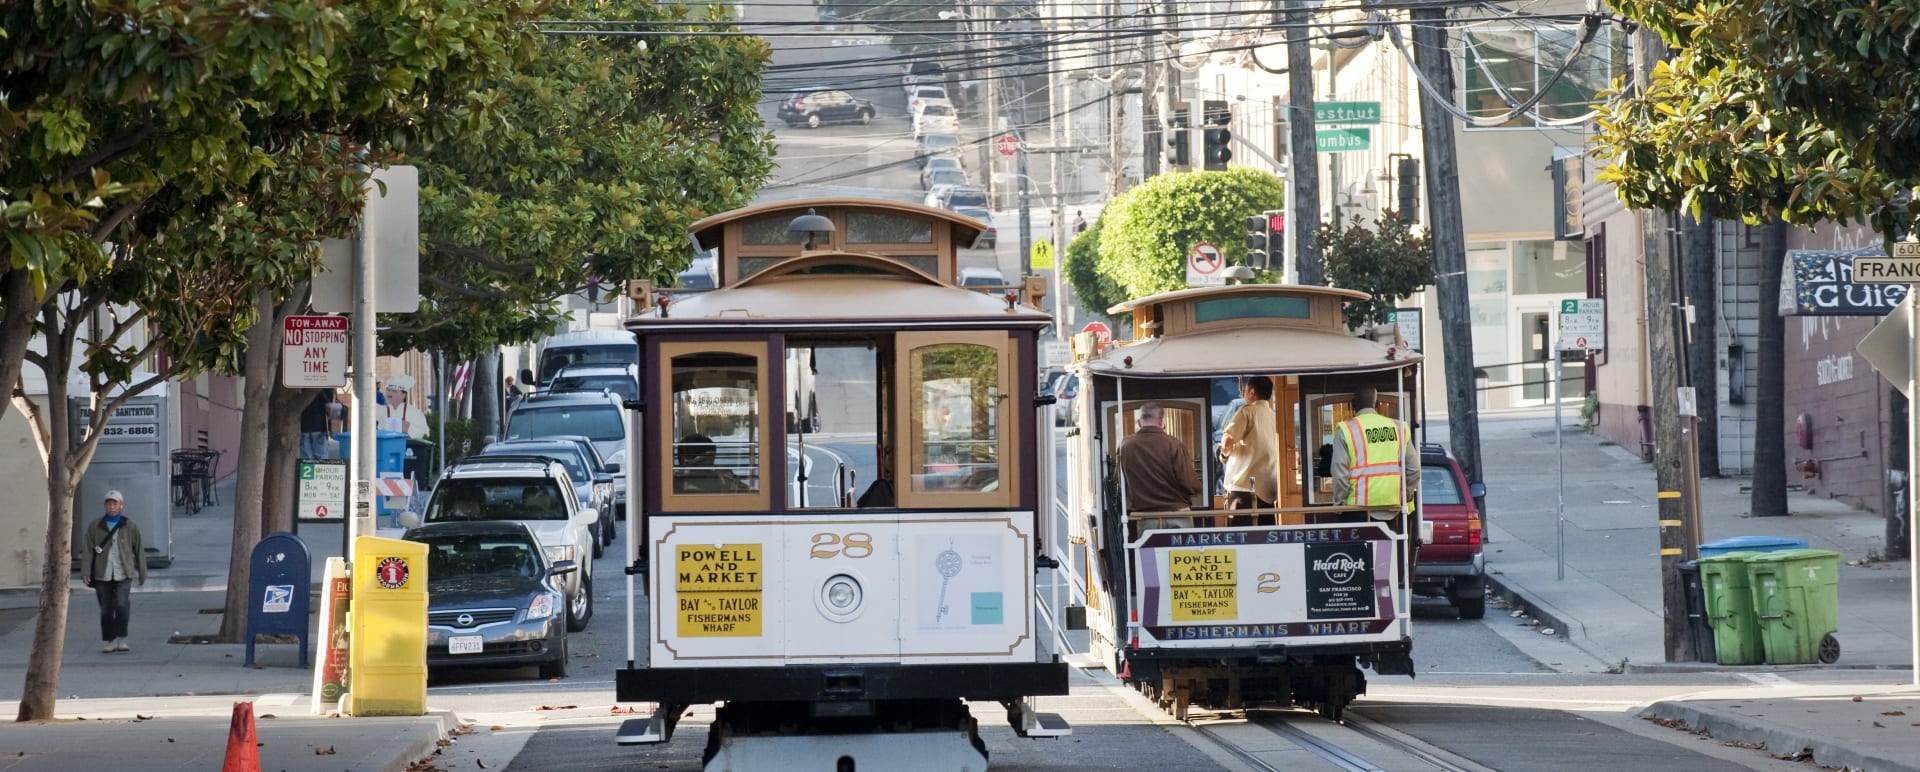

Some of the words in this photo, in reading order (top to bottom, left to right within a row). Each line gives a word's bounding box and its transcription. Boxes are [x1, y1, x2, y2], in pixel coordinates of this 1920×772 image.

[1316, 107, 1375, 119] estnut
[1316, 134, 1361, 147] umbus
[1566, 301, 1575, 312] 2
[1389, 312, 1396, 322] 2
[290, 319, 342, 328] TOW-AWAY
[285, 328, 301, 345] NO
[304, 331, 345, 344] STOPPING
[304, 347, 328, 359] ANY
[303, 361, 329, 373] TIME
[115, 407, 155, 417] SANITATION
[303, 465, 312, 478] 2
[1171, 531, 1248, 547] MARKET
[1267, 529, 1342, 543] STREET
[810, 532, 873, 559] 28
[681, 550, 757, 562] POWELL
[1174, 555, 1233, 565] POWELL
[701, 562, 738, 571] AND
[1189, 564, 1218, 572] AND
[1313, 558, 1340, 571] Hard
[1340, 558, 1365, 572] Rock
[376, 572, 409, 590] INFORMATION
[679, 572, 758, 583] MARKET
[1173, 571, 1234, 581] MARKET
[1256, 573, 1281, 593] 2
[1173, 589, 1189, 600] BAY
[1203, 588, 1234, 599] TAYLOR
[680, 598, 700, 611] BAY
[718, 598, 759, 611] TAYLOR
[1179, 600, 1229, 609] FISHERMANS
[687, 613, 752, 623] FISHERMANS
[1191, 608, 1217, 616] WHARF
[703, 623, 736, 632] WHARF
[1166, 624, 1289, 639] FISHERMANS
[1307, 621, 1372, 635] WHARF
